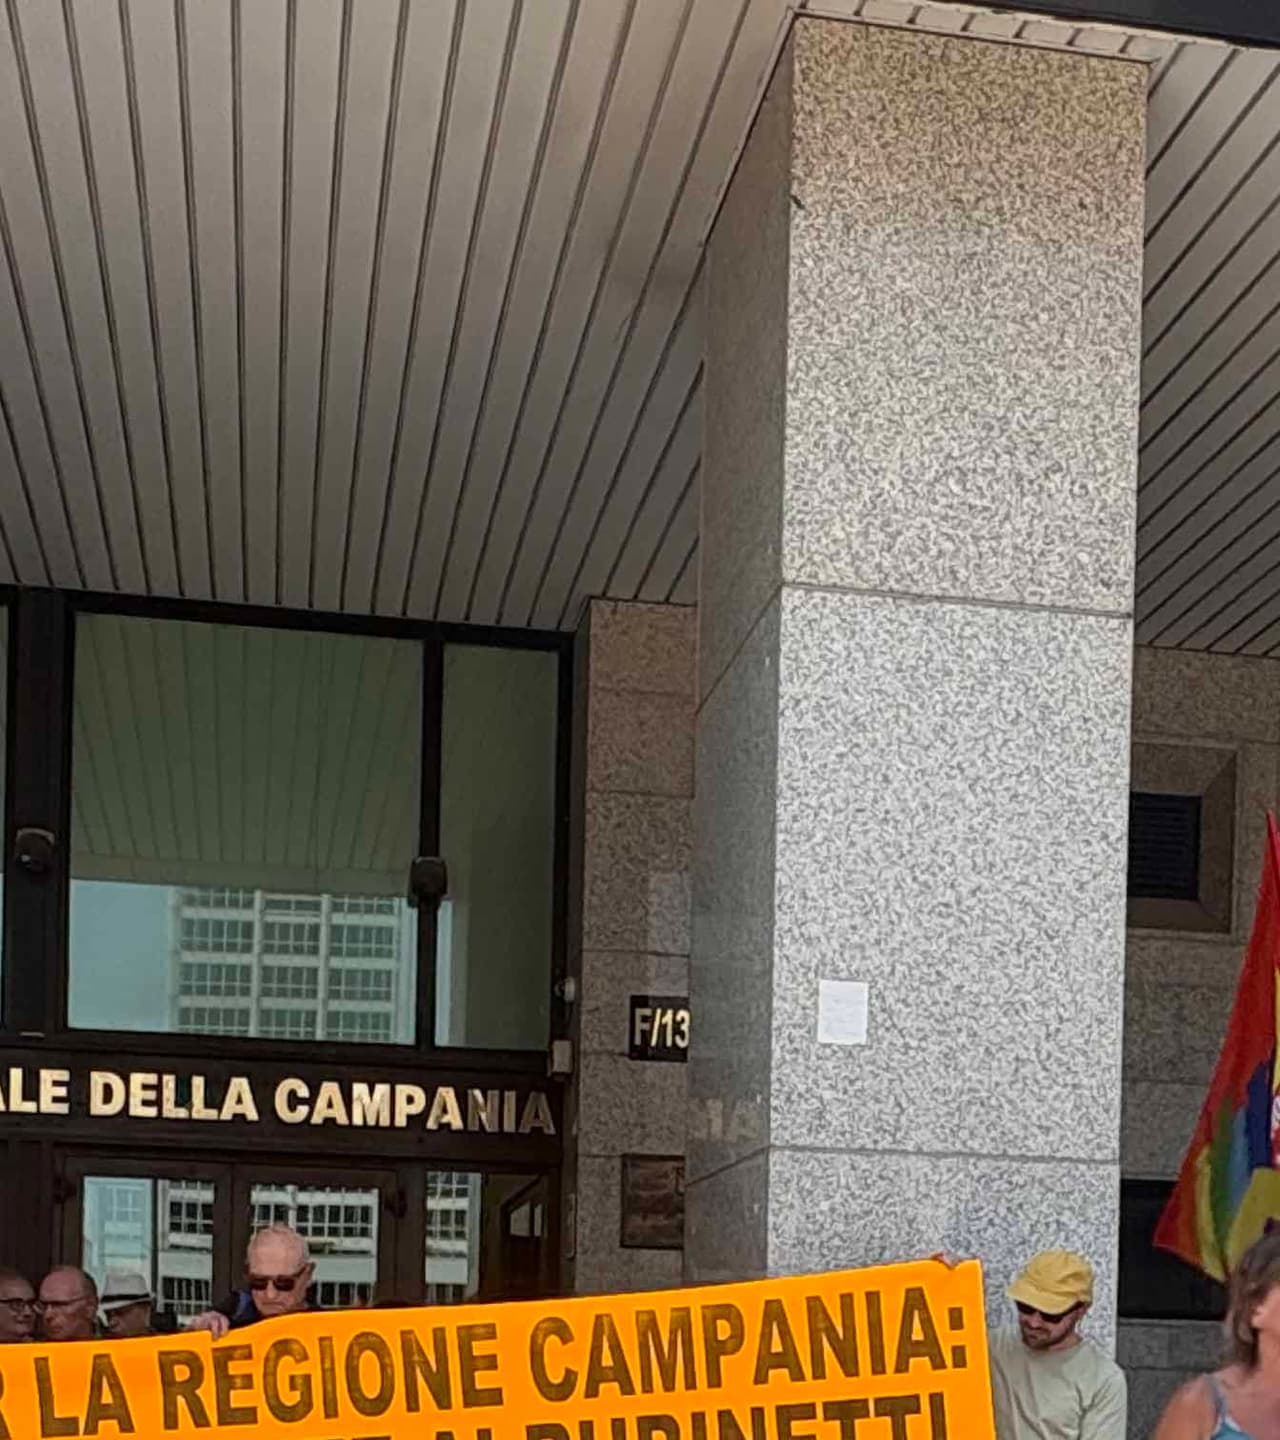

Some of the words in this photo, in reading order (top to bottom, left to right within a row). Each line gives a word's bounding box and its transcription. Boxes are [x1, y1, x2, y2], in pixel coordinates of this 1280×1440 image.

[634, 1007, 690, 1049] F/13
[89, 1070, 259, 1122] DELLA
[275, 1078, 556, 1135] CAMPANIA
[34, 1353, 135, 1438] LA
[157, 1322, 503, 1432] REGIONE
[529, 1286, 970, 1403] CAMPANIA:
